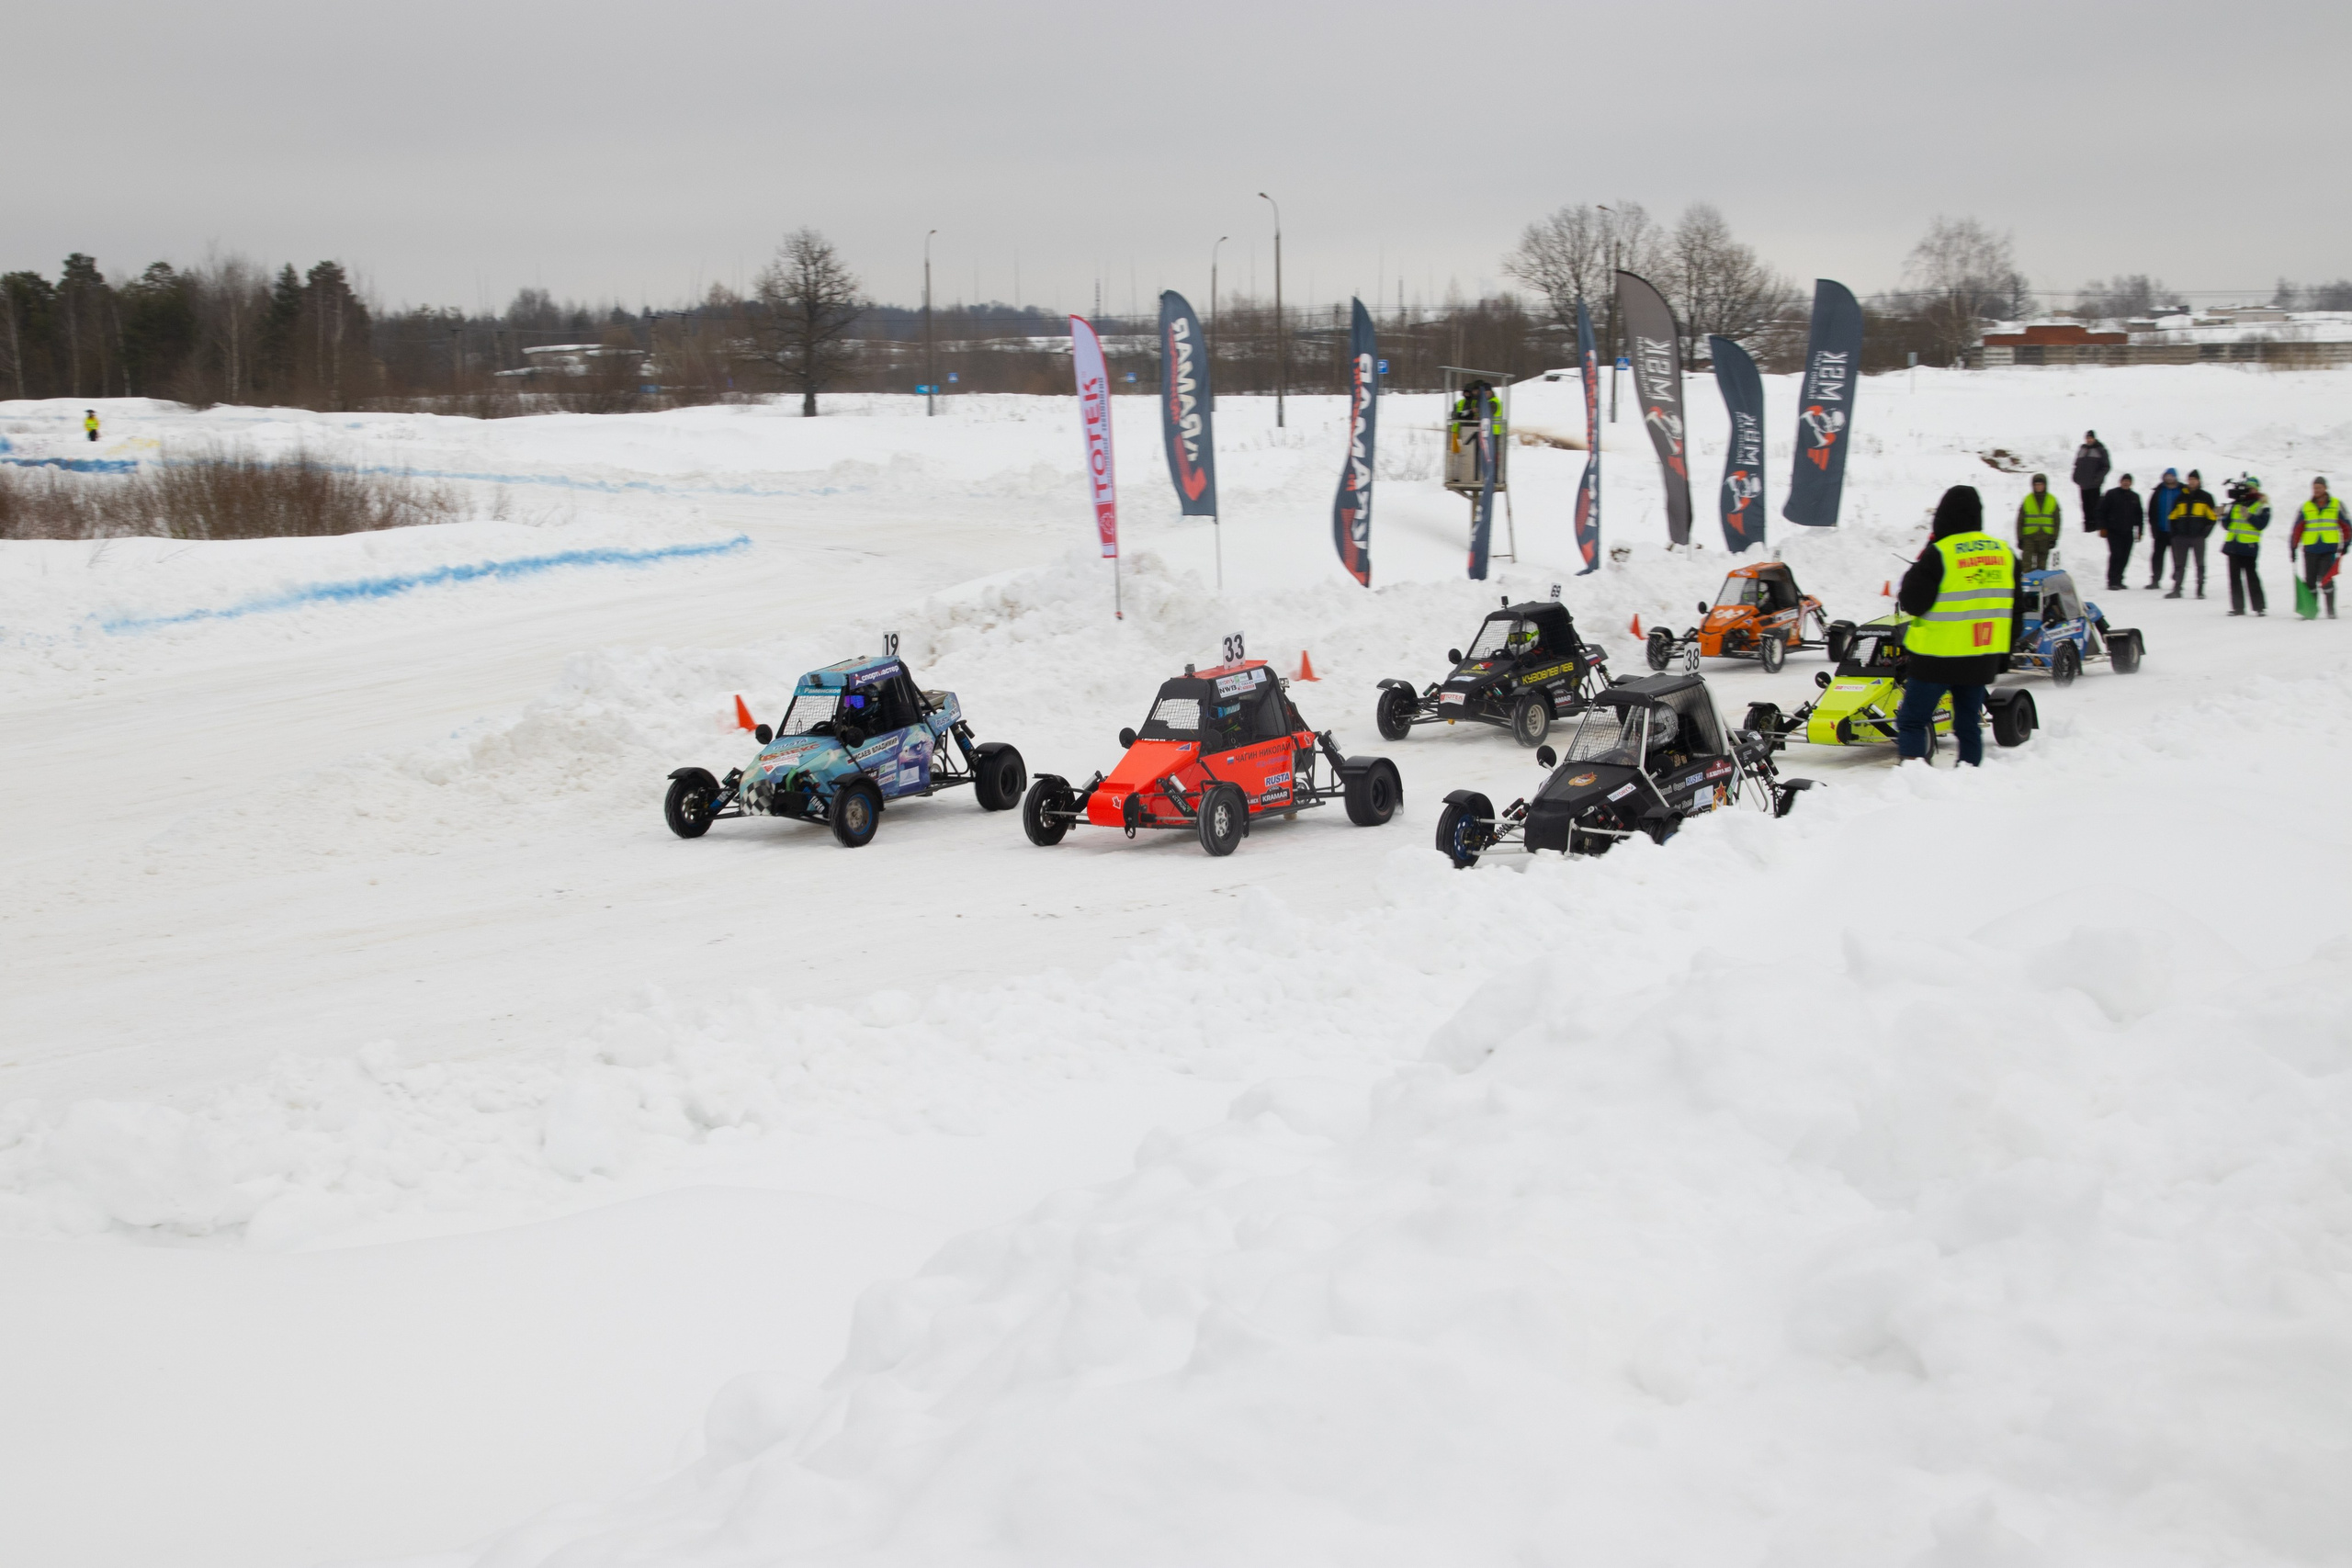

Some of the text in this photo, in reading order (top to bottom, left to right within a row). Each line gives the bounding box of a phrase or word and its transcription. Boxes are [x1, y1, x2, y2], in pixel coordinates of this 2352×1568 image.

[1082, 377, 1109, 499] TOTEK
[1955, 539, 2003, 554] RUSTA
[884, 634, 899, 656] 19
[1224, 634, 1244, 662] 33
[1685, 648, 1700, 671] 38
[1521, 666, 1559, 684] КУЗОВЛЕВ
[1559, 661, 1574, 673] ЛЕВ
[872, 737, 898, 753] ВЛАДИМИР
[1235, 752, 1258, 762] ЧАГИН
[1260, 742, 1291, 758] НИКОЛАЙ
[1265, 773, 1290, 785] RUSTA
[1686, 773, 1703, 786] RUSTA
[1261, 791, 1288, 803] KRAMAR
